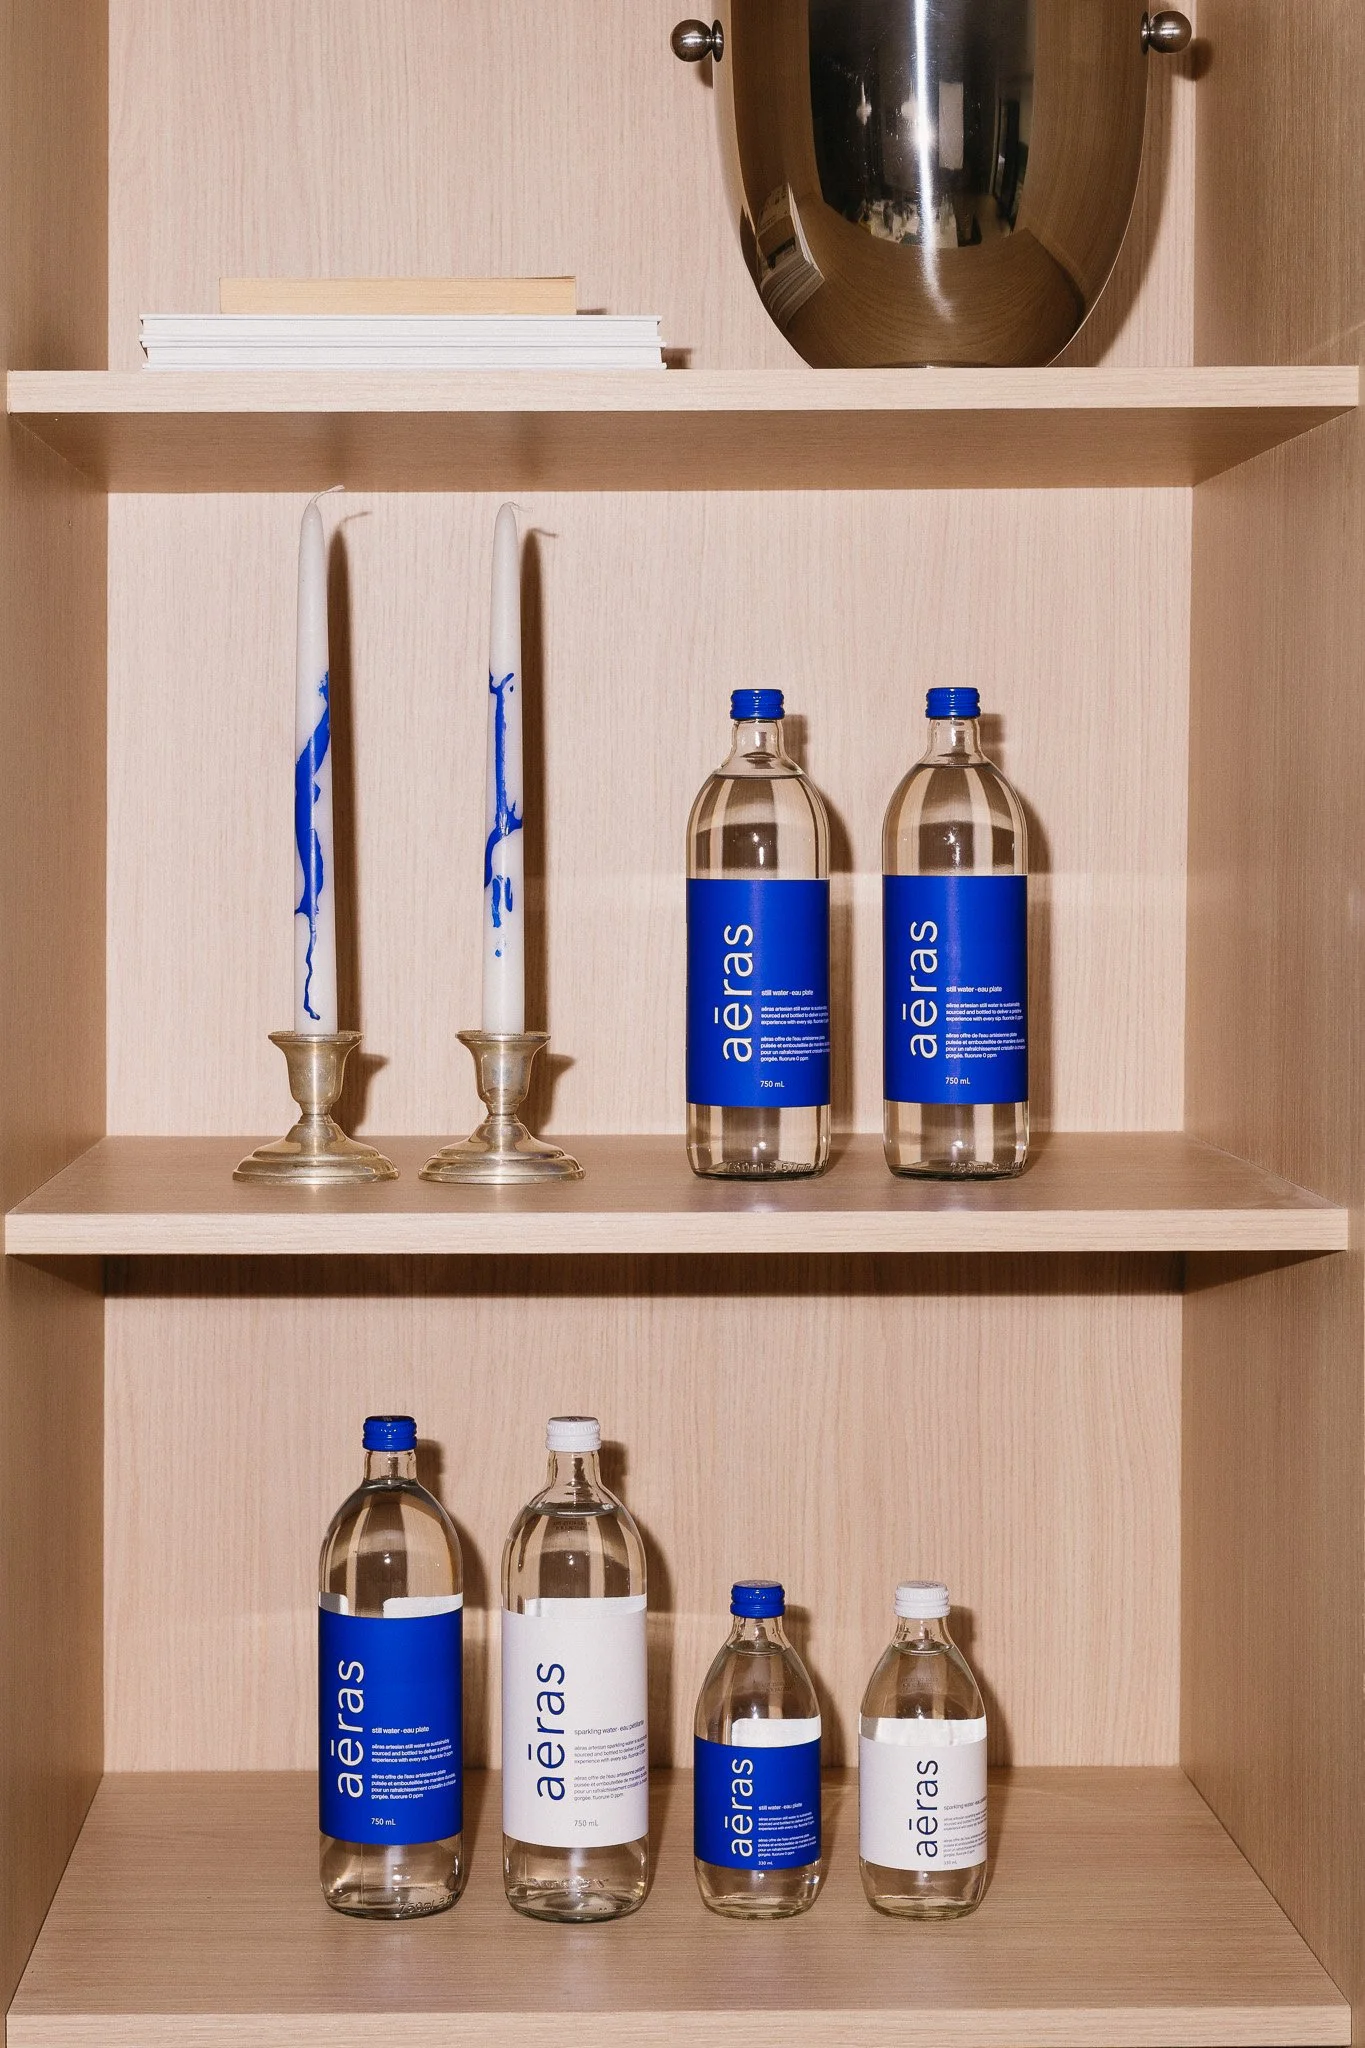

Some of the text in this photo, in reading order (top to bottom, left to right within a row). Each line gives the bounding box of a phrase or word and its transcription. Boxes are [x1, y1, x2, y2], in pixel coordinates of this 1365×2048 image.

[715, 923, 753, 1063] aēras
[902, 920, 938, 1059] aēras
[331, 1659, 364, 1798] aēras
[415, 1726, 429, 1734] plate
[527, 1662, 565, 1801] aēras
[574, 1728, 601, 1736] sparkling
[724, 1758, 753, 1857] aēras
[909, 1760, 938, 1858] aēras
